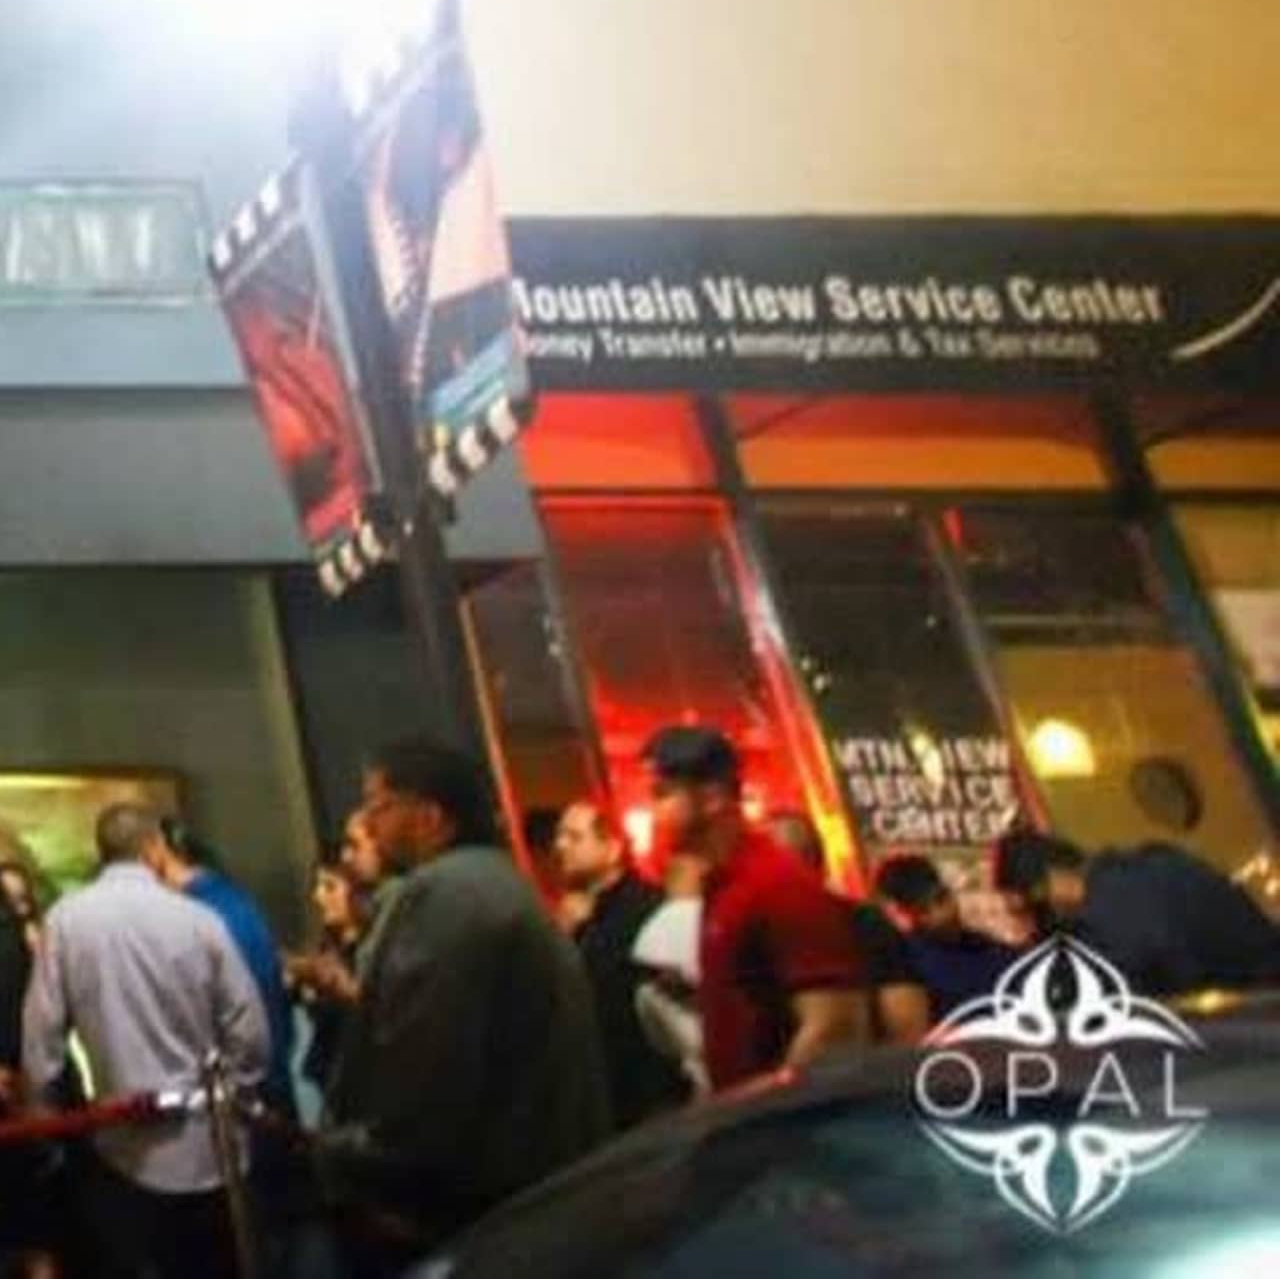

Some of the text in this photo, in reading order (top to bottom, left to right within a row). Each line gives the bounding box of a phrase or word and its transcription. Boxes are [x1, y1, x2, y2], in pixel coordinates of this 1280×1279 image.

[702, 276, 815, 321] View
[825, 275, 1002, 321] Service
[1007, 276, 1166, 321] Center
[848, 773, 1014, 808] SERVICE
